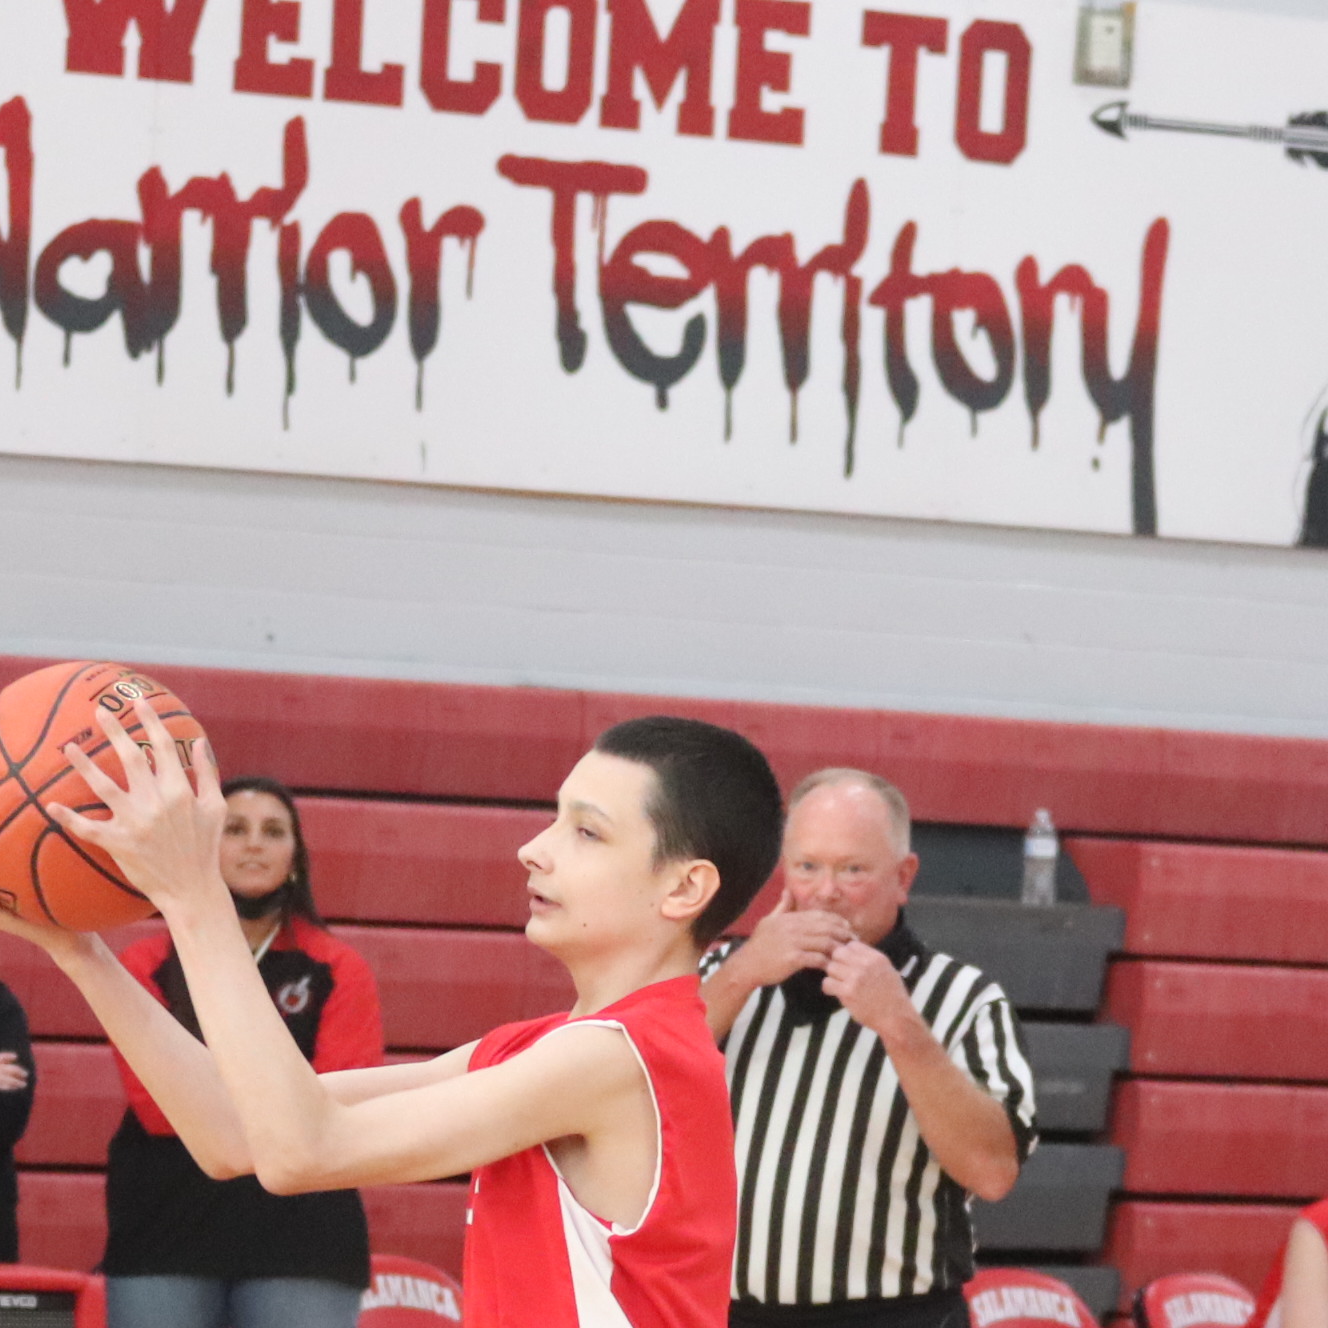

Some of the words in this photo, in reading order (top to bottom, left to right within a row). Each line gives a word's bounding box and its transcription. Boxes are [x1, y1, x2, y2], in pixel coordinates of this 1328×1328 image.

[65, 0, 811, 147] WELCOME
[860, 10, 1033, 166] TO
[496, 154, 1170, 538] Territory
[360, 1274, 461, 1322] LAMANCA
[972, 1286, 1083, 1328] SALAMANCA
